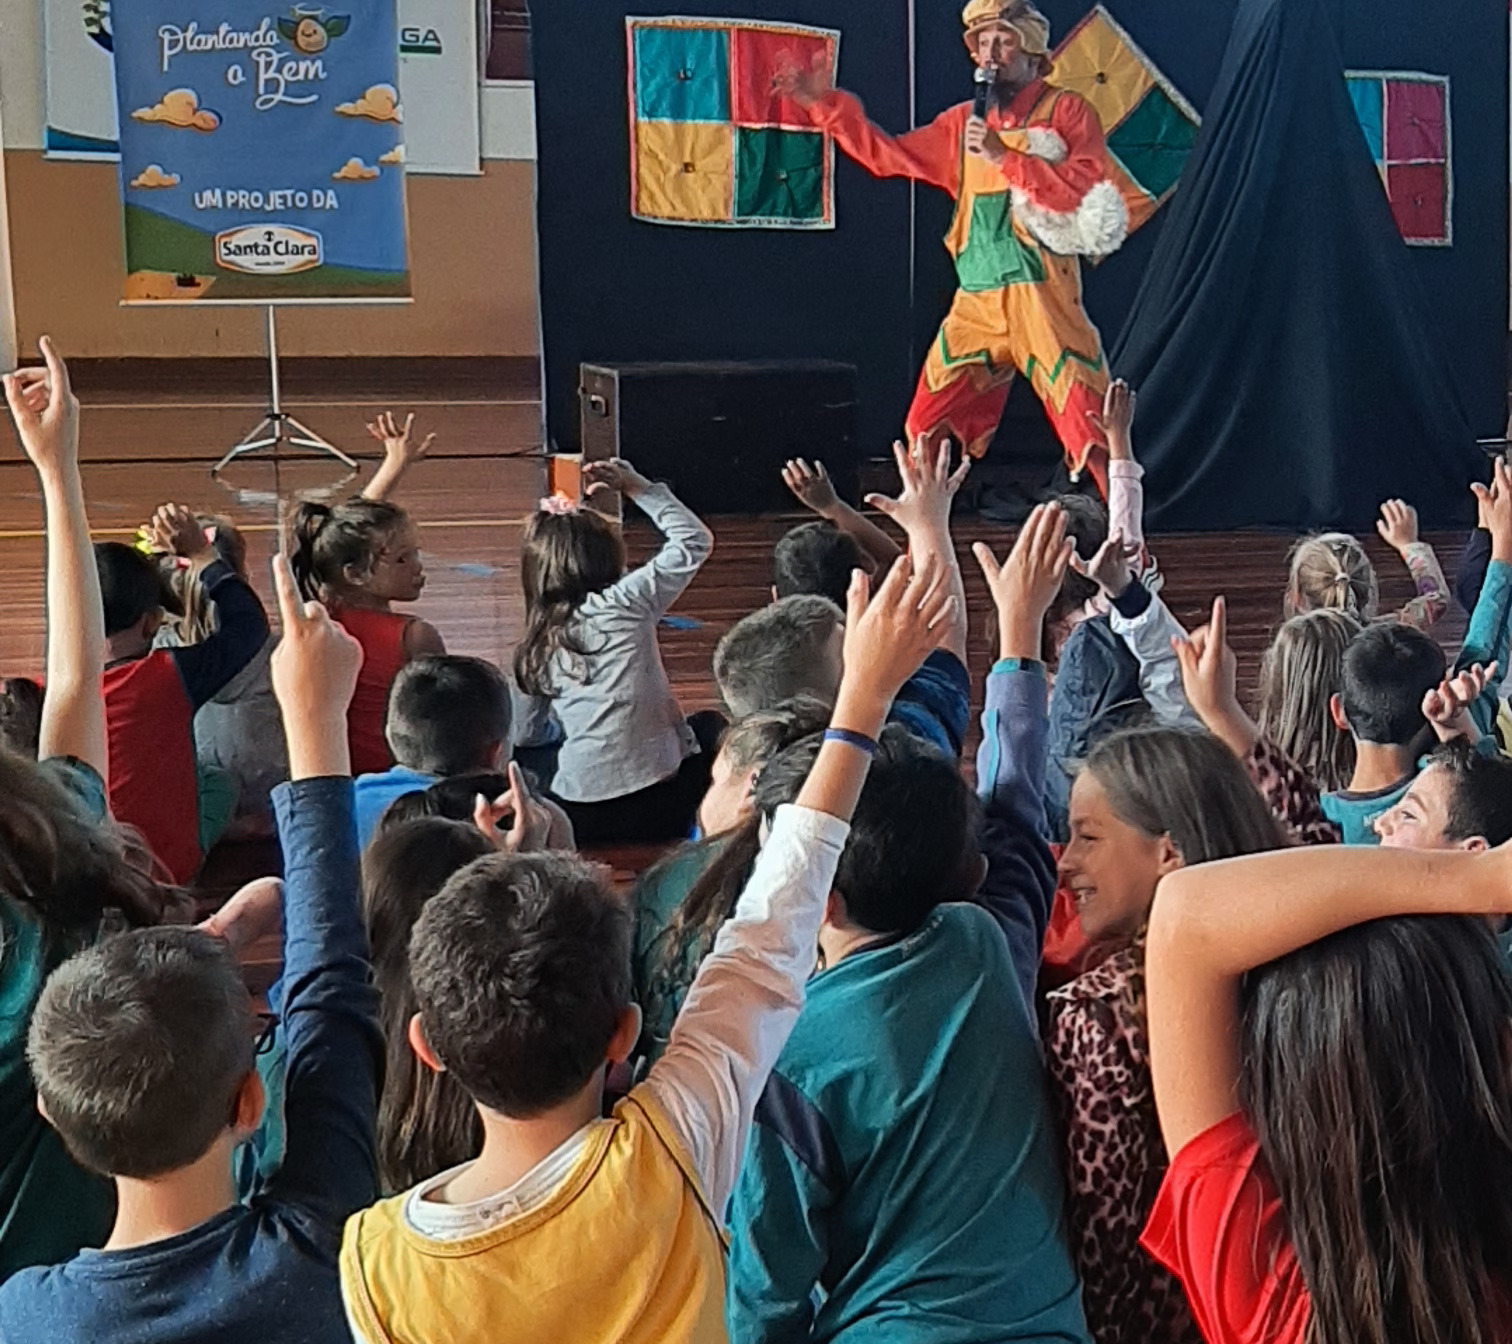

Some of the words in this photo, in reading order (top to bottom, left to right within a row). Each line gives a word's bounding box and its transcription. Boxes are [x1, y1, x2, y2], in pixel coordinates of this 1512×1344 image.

[158, 16, 280, 72] Plantando
[251, 47, 328, 110] Bem
[193, 187, 223, 209] UM
[225, 189, 309, 212] PROJETO
[311, 189, 339, 209] DA
[222, 239, 271, 257] Santa
[272, 238, 318, 257] Clara
